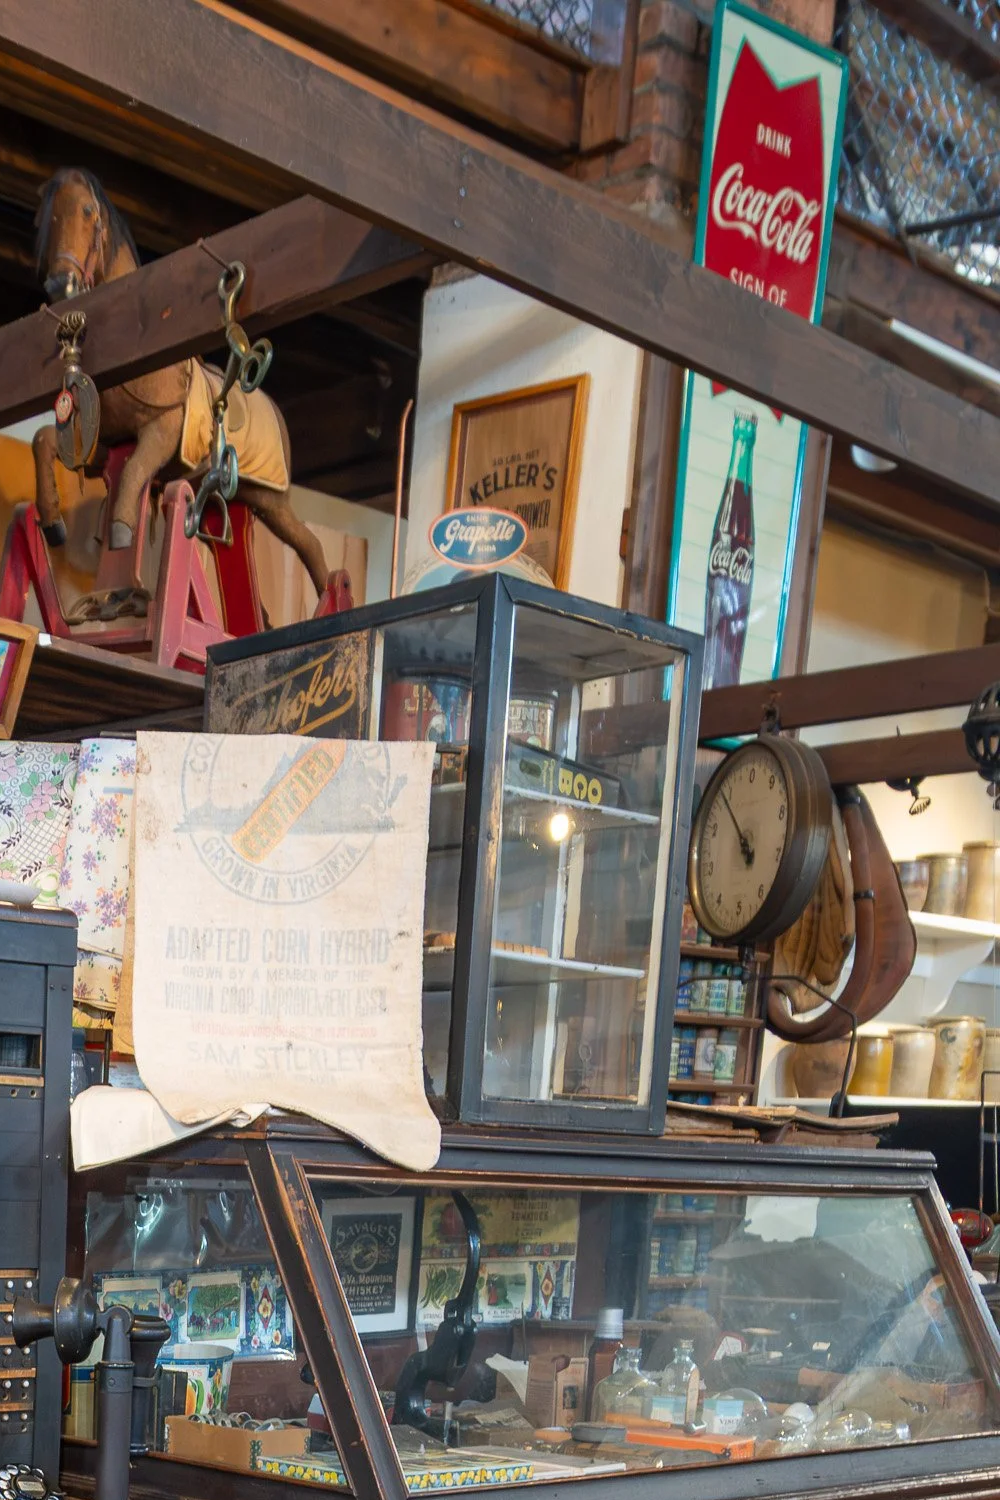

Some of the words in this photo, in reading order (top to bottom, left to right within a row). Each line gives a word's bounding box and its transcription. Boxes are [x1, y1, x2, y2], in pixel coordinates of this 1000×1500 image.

[756, 122, 792, 160] DRINK
[712, 161, 821, 264] Coca-Cola
[729, 266, 765, 298] SIGN
[768, 284, 788, 308] OF
[469, 460, 558, 506] KELLER'S
[439, 518, 516, 556] Grapette
[240, 748, 335, 858] CERTIFIED
[202, 836, 260, 895] GROWN
[261, 876, 279, 899] IN
[286, 844, 362, 898] VIRGINIA
[165, 925, 251, 964] ADAPTED
[262, 928, 310, 965] CORN
[320, 928, 391, 965] HYBRID
[182, 966, 223, 979] GROWN
[229, 967, 245, 980] BY
[252, 968, 260, 981] A
[266, 969, 318, 983] MEMBER
[324, 970, 338, 983] OF
[345, 970, 372, 983] THE
[164, 982, 215, 1014] VIRGINIA
[221, 984, 255, 1016] CROP
[260, 985, 352, 1018] IMPROVEMENT
[186, 1040, 240, 1068] SAM
[253, 1044, 368, 1073] STICKLEY
[335, 1221, 397, 1249] SAVAGE'S
[359, 1274, 393, 1284] MOUNTAIN
